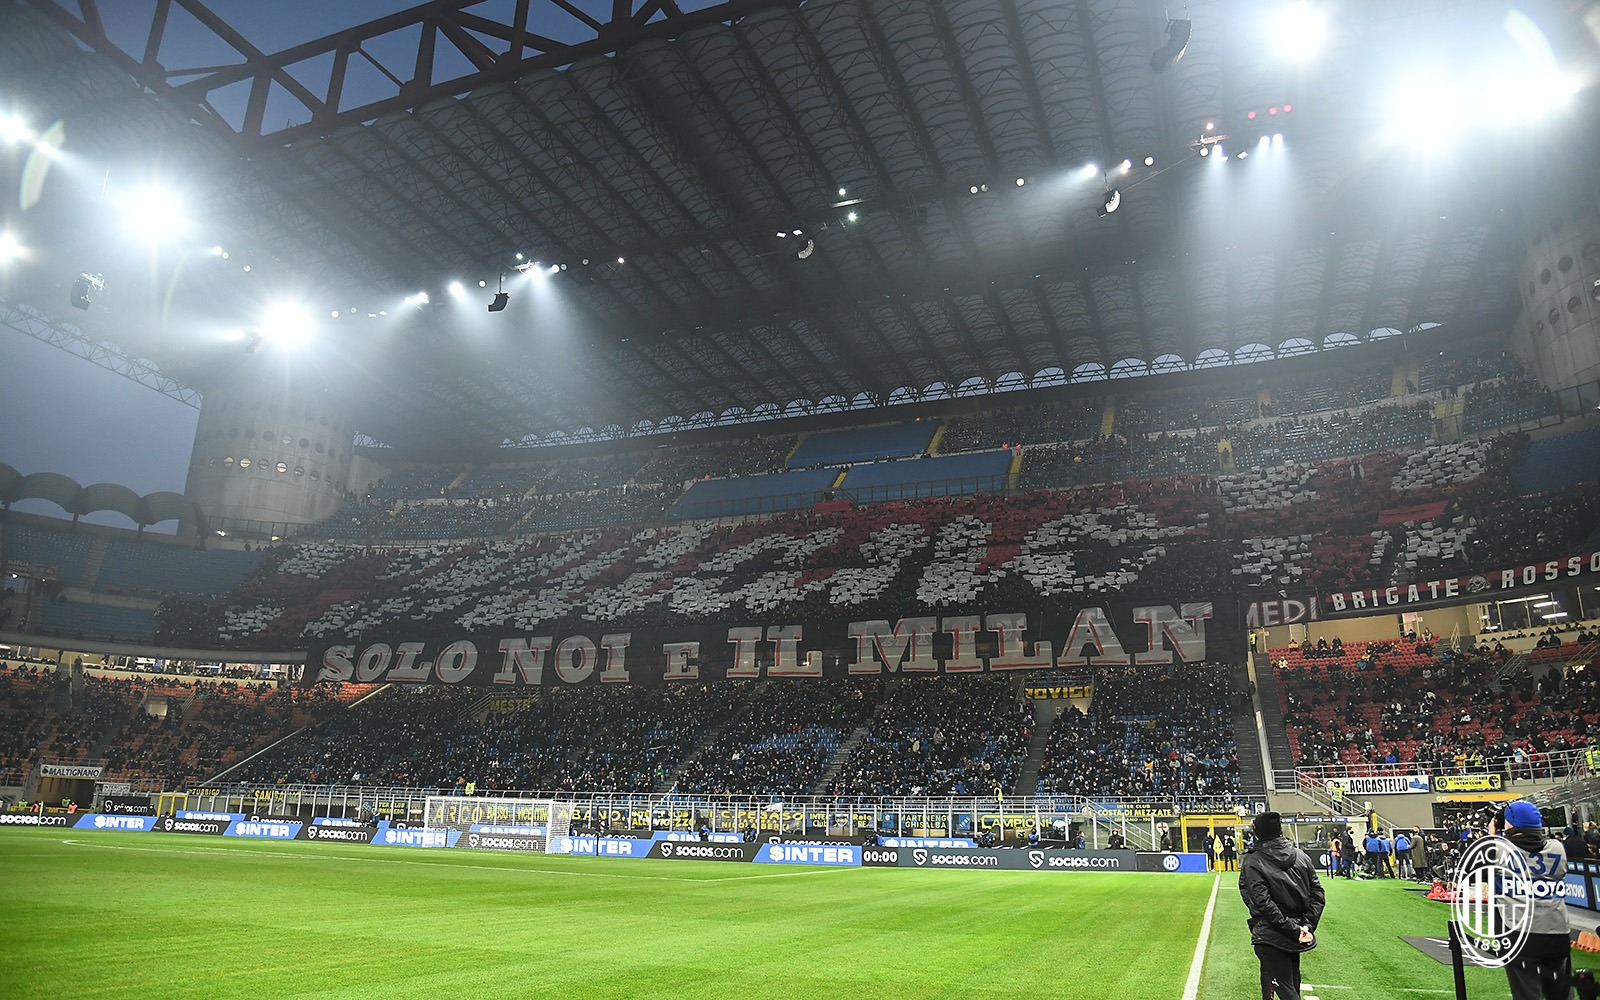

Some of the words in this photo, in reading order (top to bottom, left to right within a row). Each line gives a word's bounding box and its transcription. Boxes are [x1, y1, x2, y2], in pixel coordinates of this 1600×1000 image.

[1332, 578, 1459, 611] BRIGATE
[317, 640, 478, 684] SOLO
[493, 633, 631, 685] NOI
[726, 625, 823, 678] IL
[848, 602, 1213, 675] MILAN
[48, 767, 100, 777] MALTIGNANO
[1350, 777, 1409, 793] ACICASTELLO
[433, 805, 483, 823] ARCO
[1134, 808, 1172, 816] MEZZATE
[863, 851, 898, 862] 00:00
[1503, 879, 1565, 897] PHOTO
